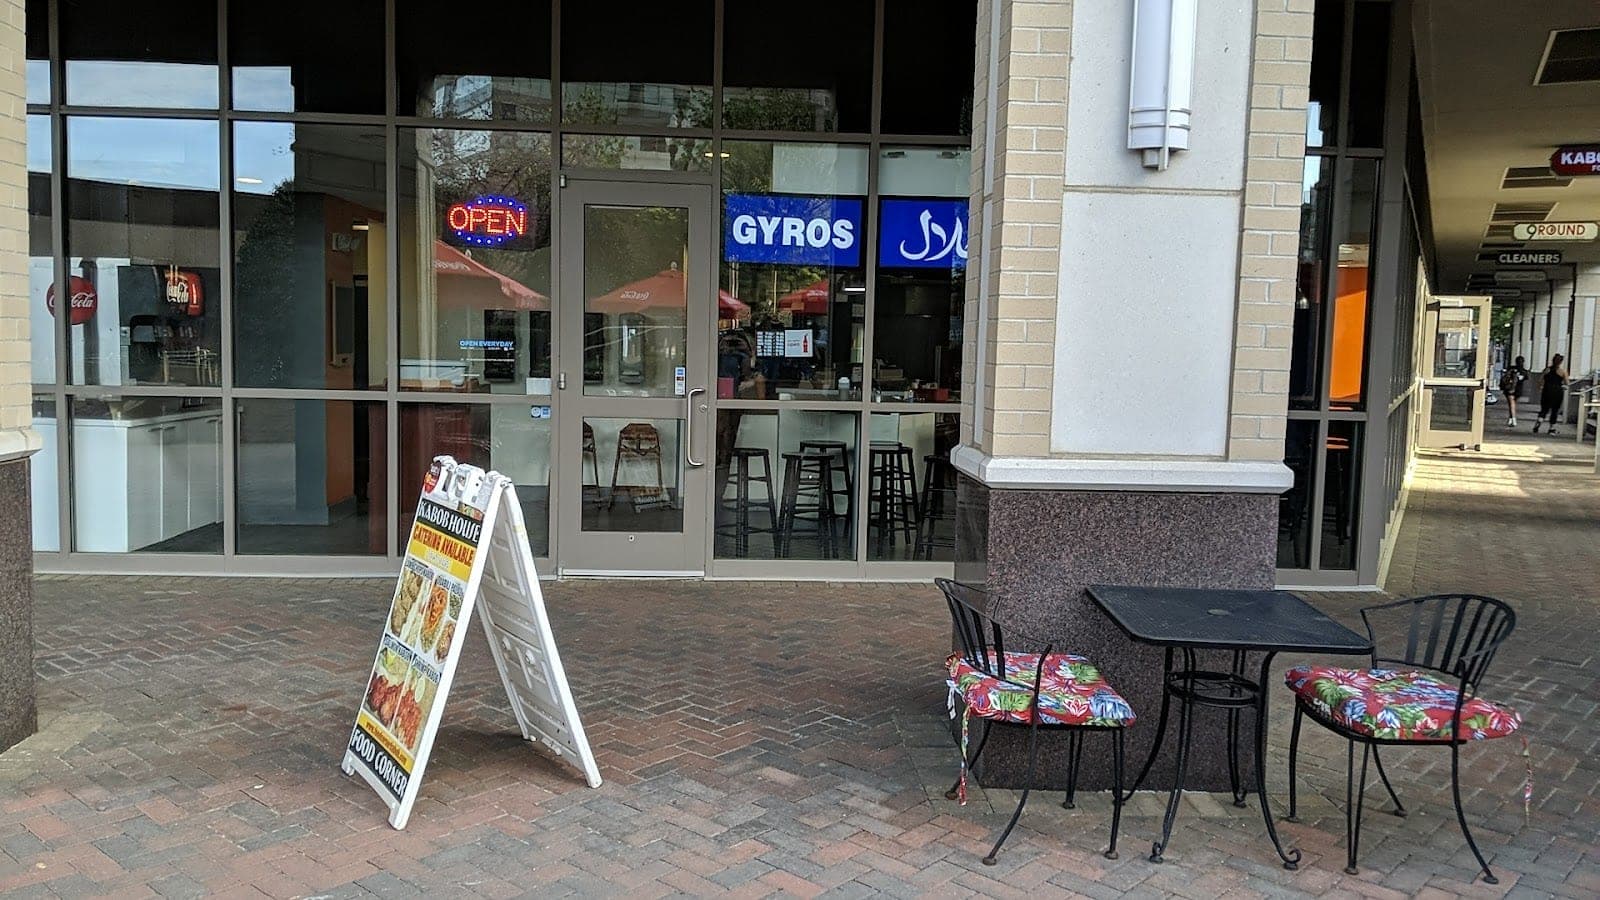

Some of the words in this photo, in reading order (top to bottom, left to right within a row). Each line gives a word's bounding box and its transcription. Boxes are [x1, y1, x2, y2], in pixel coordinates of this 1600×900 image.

[449, 205, 527, 236] OPEN
[732, 214, 854, 250] GYROS
[1498, 253, 1561, 264] CLEANERS
[417, 501, 451, 527] KABOB
[446, 514, 482, 542] HOUSE
[412, 524, 442, 550] CATERING
[440, 537, 475, 565] AVAILABLE
[351, 726, 376, 766] FOOD
[372, 747, 408, 799] CORNER
